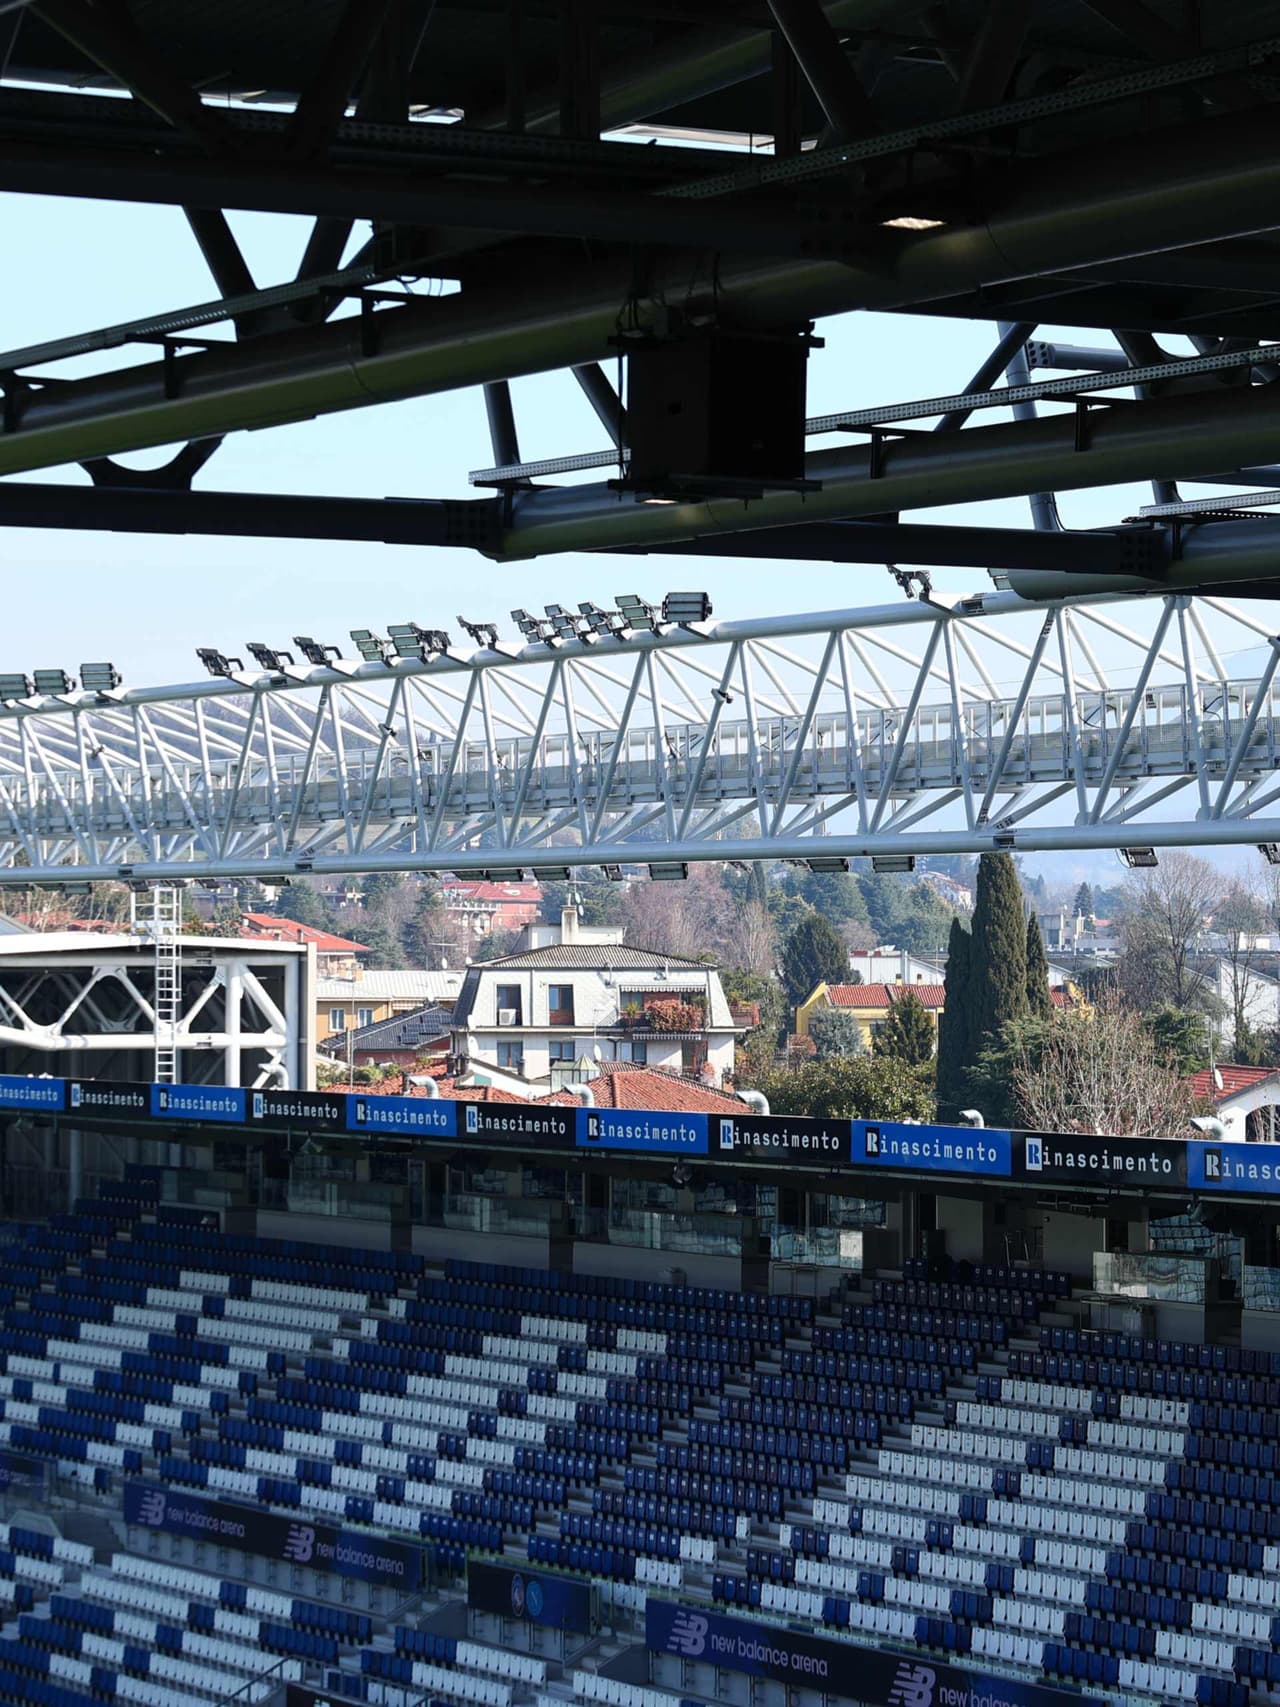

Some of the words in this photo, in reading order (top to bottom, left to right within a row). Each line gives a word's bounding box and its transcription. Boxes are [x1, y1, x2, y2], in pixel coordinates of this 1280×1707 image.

[71, 1084, 145, 1107] Rinascimento
[159, 1091, 238, 1112] Rinascimento
[253, 1093, 338, 1119] Rinascimento
[356, 1102, 448, 1126] Rinascimento
[466, 1105, 566, 1135] Rinascimento
[588, 1117, 697, 1142] Rinascimento
[720, 1119, 840, 1150] Rinascimento
[866, 1131, 998, 1162] Rinascimento
[1026, 1137, 1173, 1174] Rinascimento
[167, 1506, 184, 1522] new
[317, 1543, 335, 1559] new
[336, 1544, 375, 1568] balance
[375, 1554, 404, 1576] arena
[711, 1634, 736, 1654] new
[738, 1636, 789, 1667] balance
[791, 1653, 828, 1677] arena
[940, 1687, 967, 1707] new
